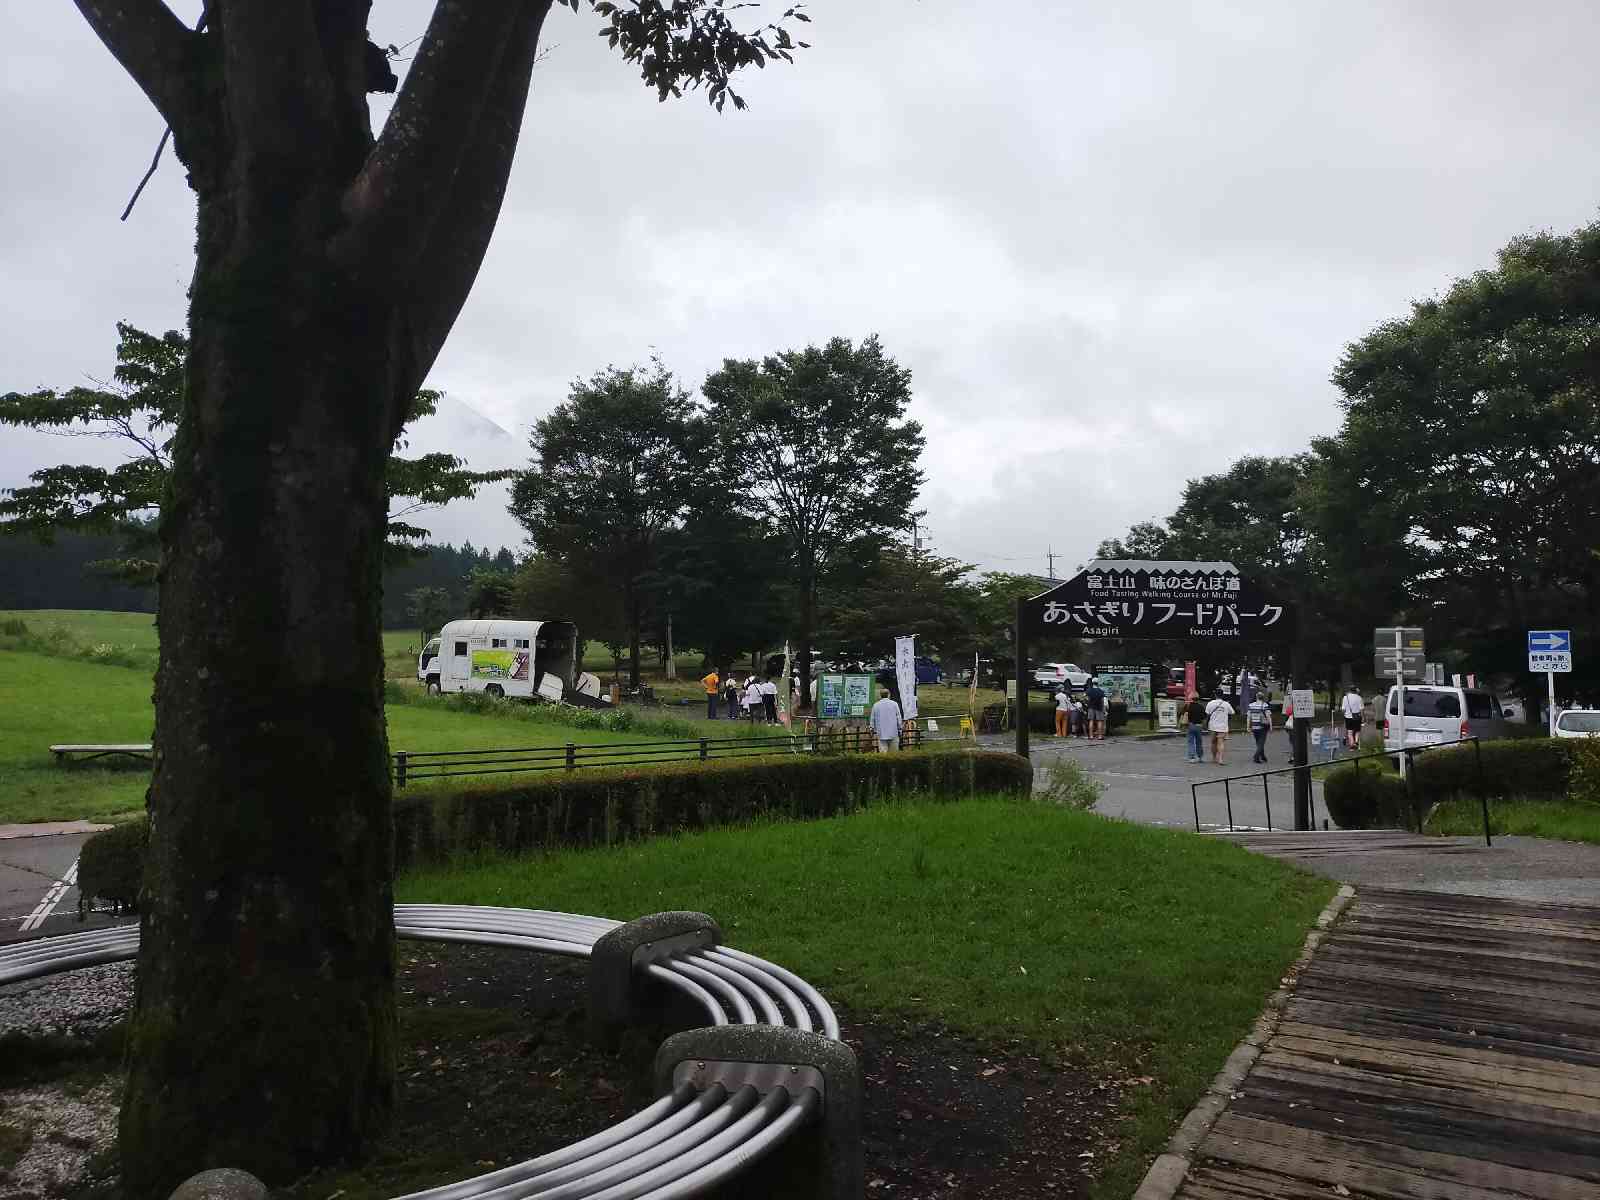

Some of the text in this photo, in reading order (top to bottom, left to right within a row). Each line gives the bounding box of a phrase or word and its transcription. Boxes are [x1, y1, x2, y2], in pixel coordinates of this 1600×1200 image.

[1086, 574, 1241, 591] 富士山 味のさんぽ道
[1090, 589, 1109, 597] Food
[1112, 589, 1139, 599] Tasting
[1141, 590, 1171, 599] Walking
[1173, 591, 1199, 599] Course
[1081, 626, 1119, 636] Asagiri
[1189, 627, 1241, 637] food park
